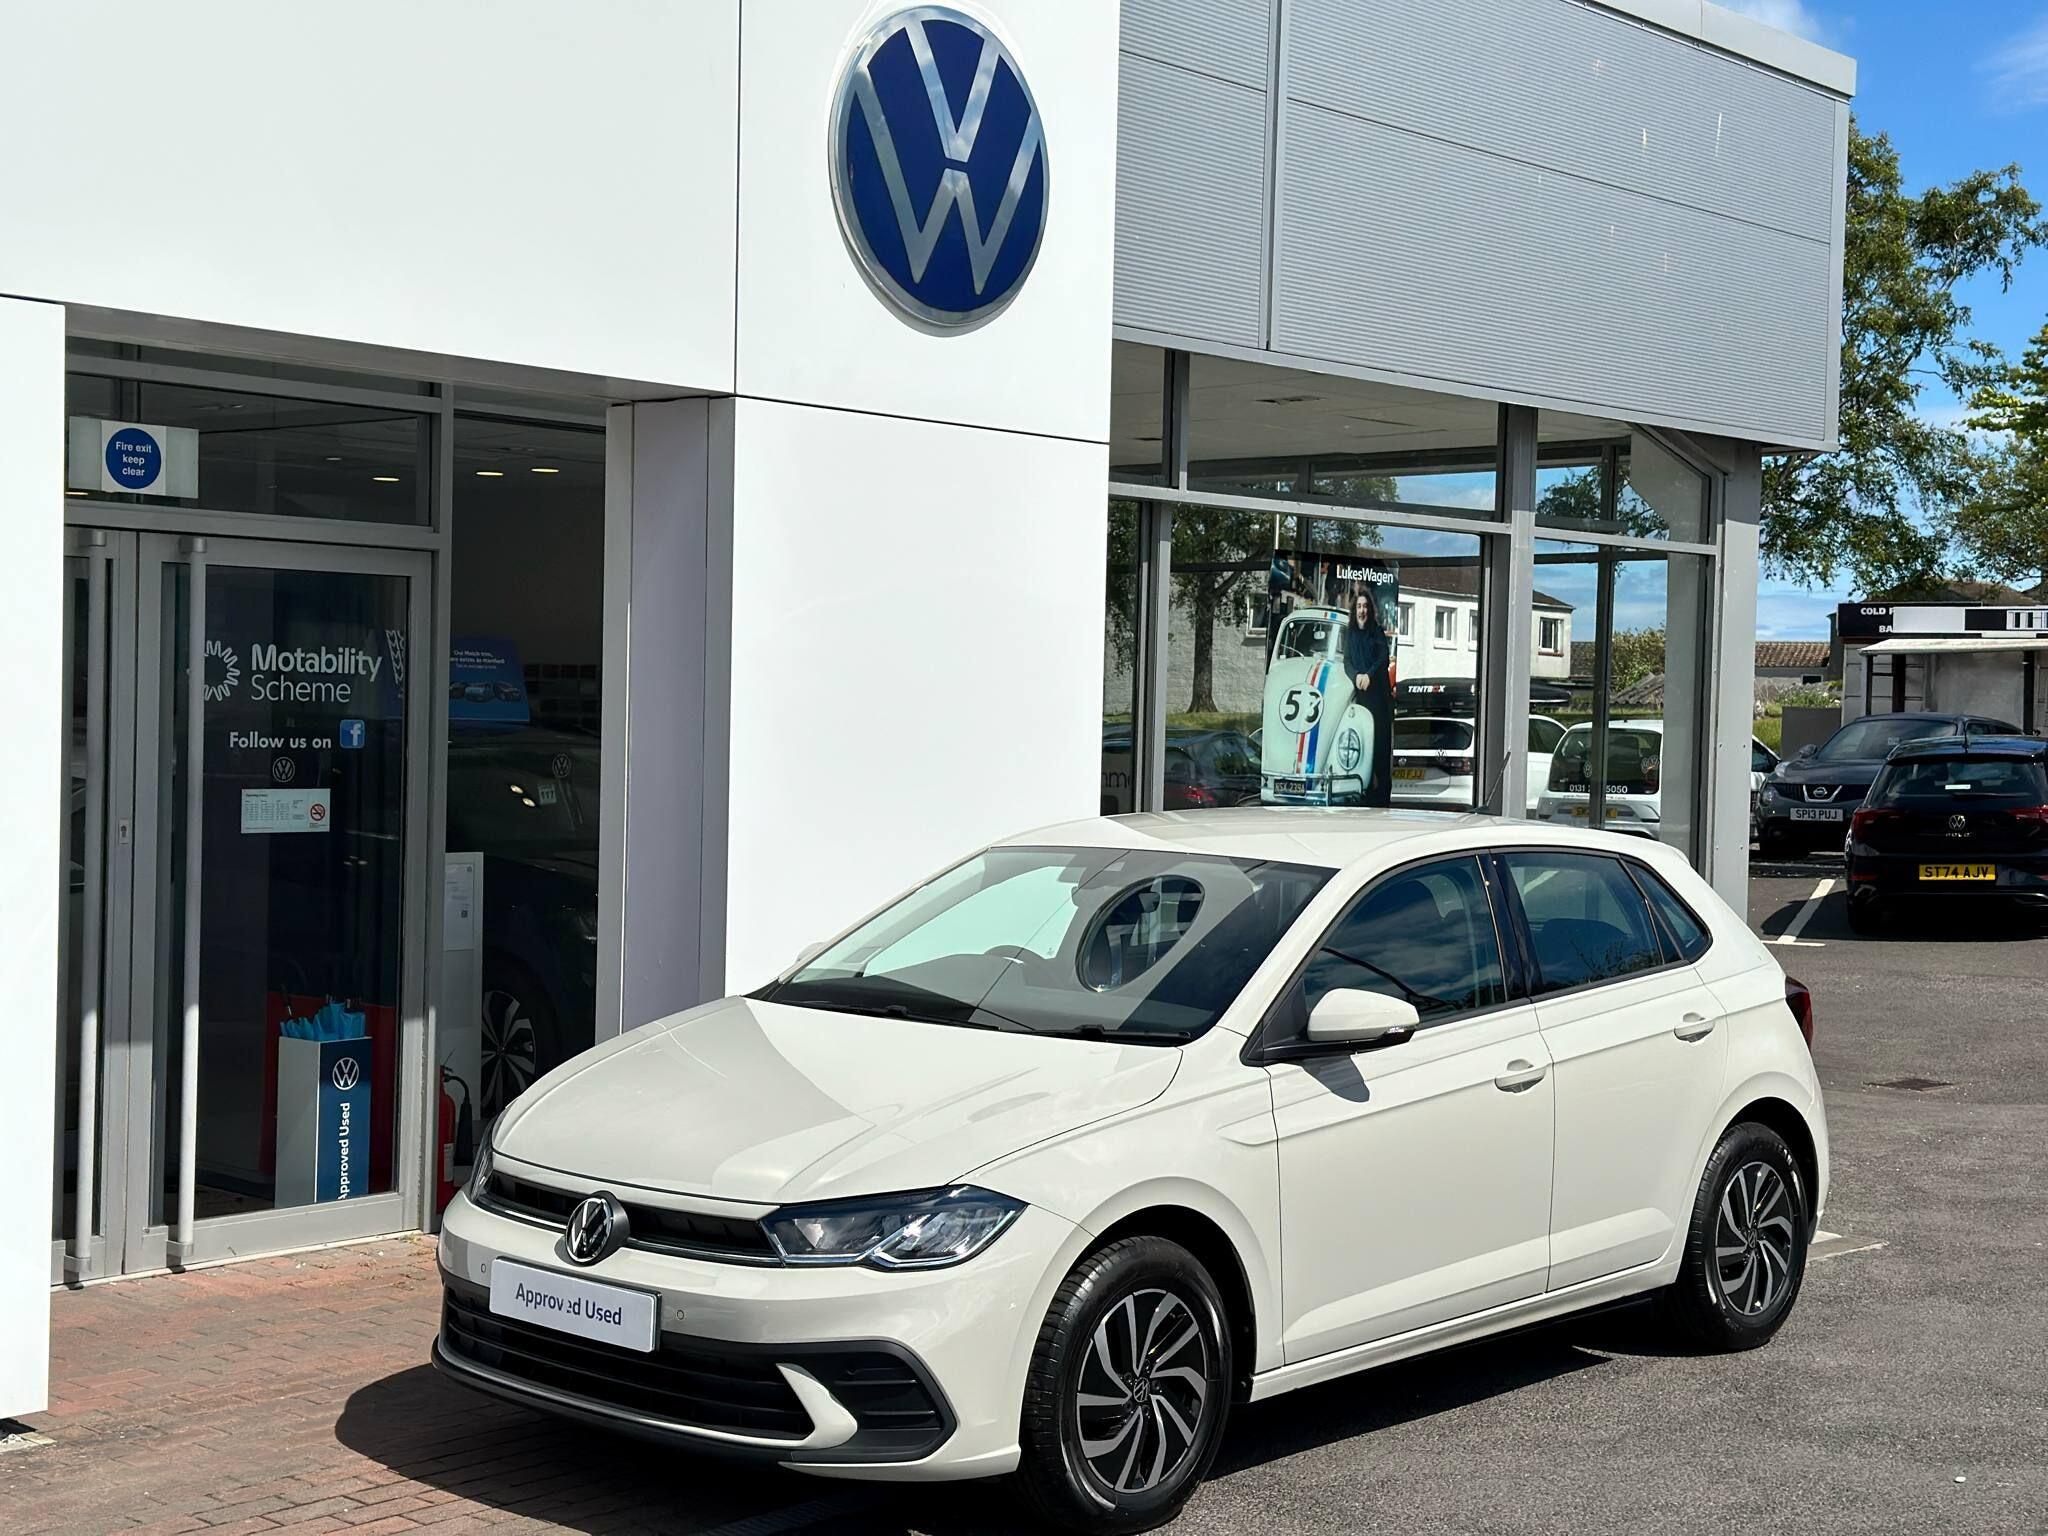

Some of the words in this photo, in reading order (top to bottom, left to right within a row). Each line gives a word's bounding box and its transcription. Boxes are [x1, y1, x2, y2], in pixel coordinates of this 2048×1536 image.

[115, 441, 133, 451] Fire
[135, 443, 152, 453] exit
[122, 454, 145, 466] keep
[122, 467, 145, 476] clear
[1336, 564, 1394, 585] LukesWagen
[1860, 607, 1887, 616] COLD
[251, 643, 383, 682] Motability
[251, 674, 351, 703] Scheme
[1408, 685, 1446, 693] TENTBOX
[1284, 690, 1321, 723] 53
[229, 731, 285, 749] Follow
[289, 737, 307, 749] us
[312, 737, 332, 749] on
[1569, 784, 1586, 792] 0131
[1796, 809, 1816, 819] SP13
[1818, 810, 1838, 820] PUJ
[1924, 866, 1959, 878] ST74
[1963, 866, 1989, 878] AJV
[339, 1102, 350, 1137] Used
[585, 1300, 622, 1326] Used
